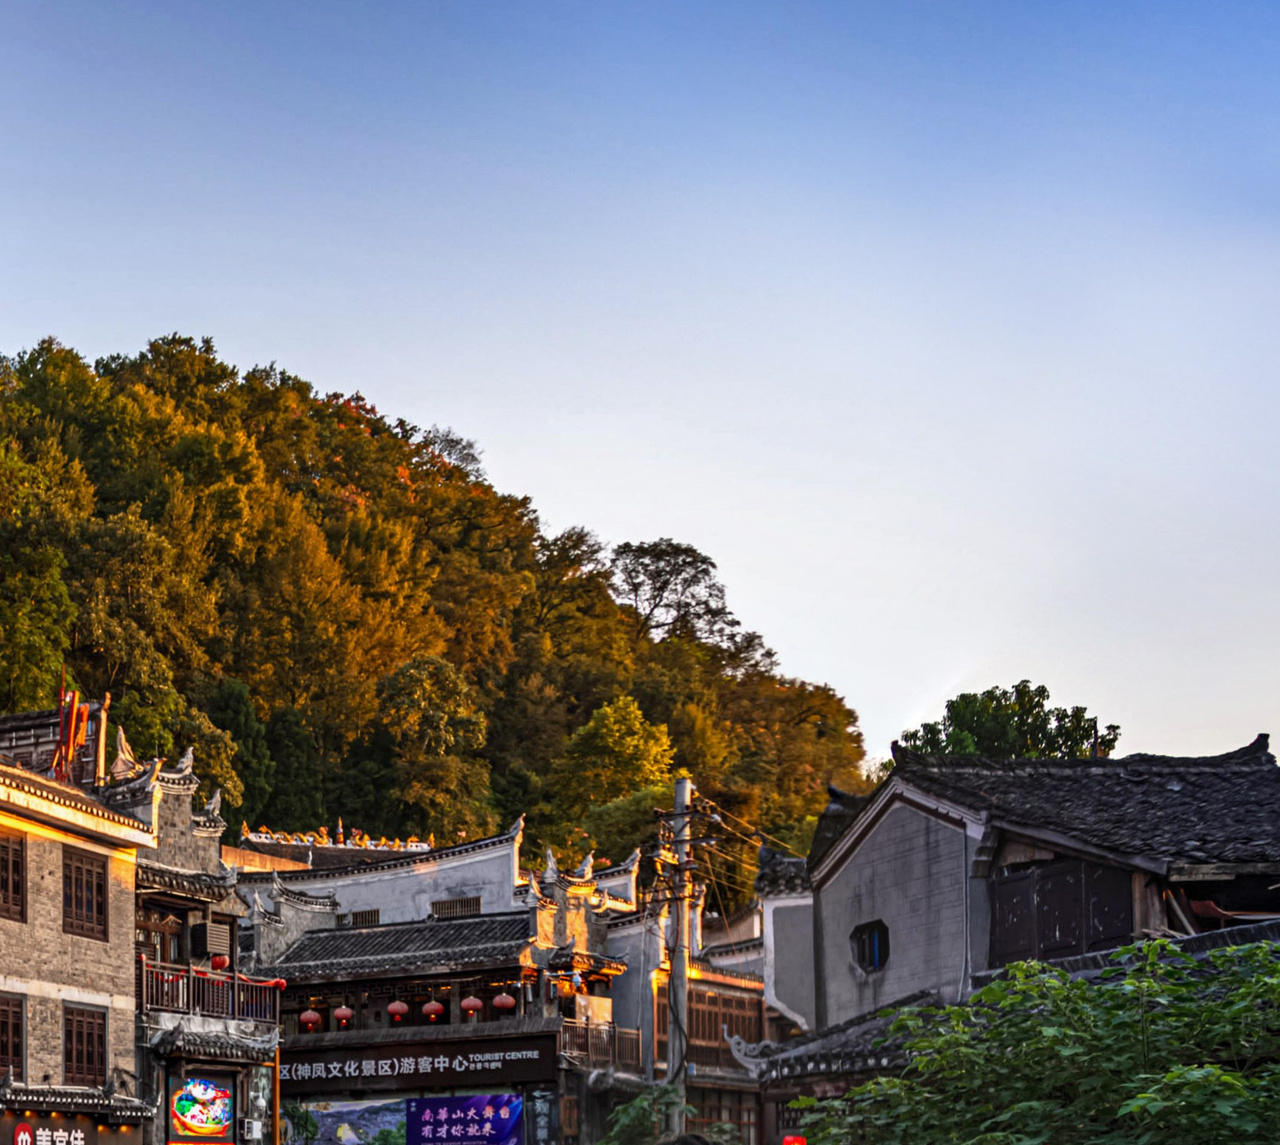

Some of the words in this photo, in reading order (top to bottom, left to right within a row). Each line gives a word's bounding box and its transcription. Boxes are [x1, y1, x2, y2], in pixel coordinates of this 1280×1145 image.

[468, 1053, 504, 1062] TOURIST
[505, 1050, 540, 1060] CENTRE
[421, 1122, 496, 1138] 有才你就来
